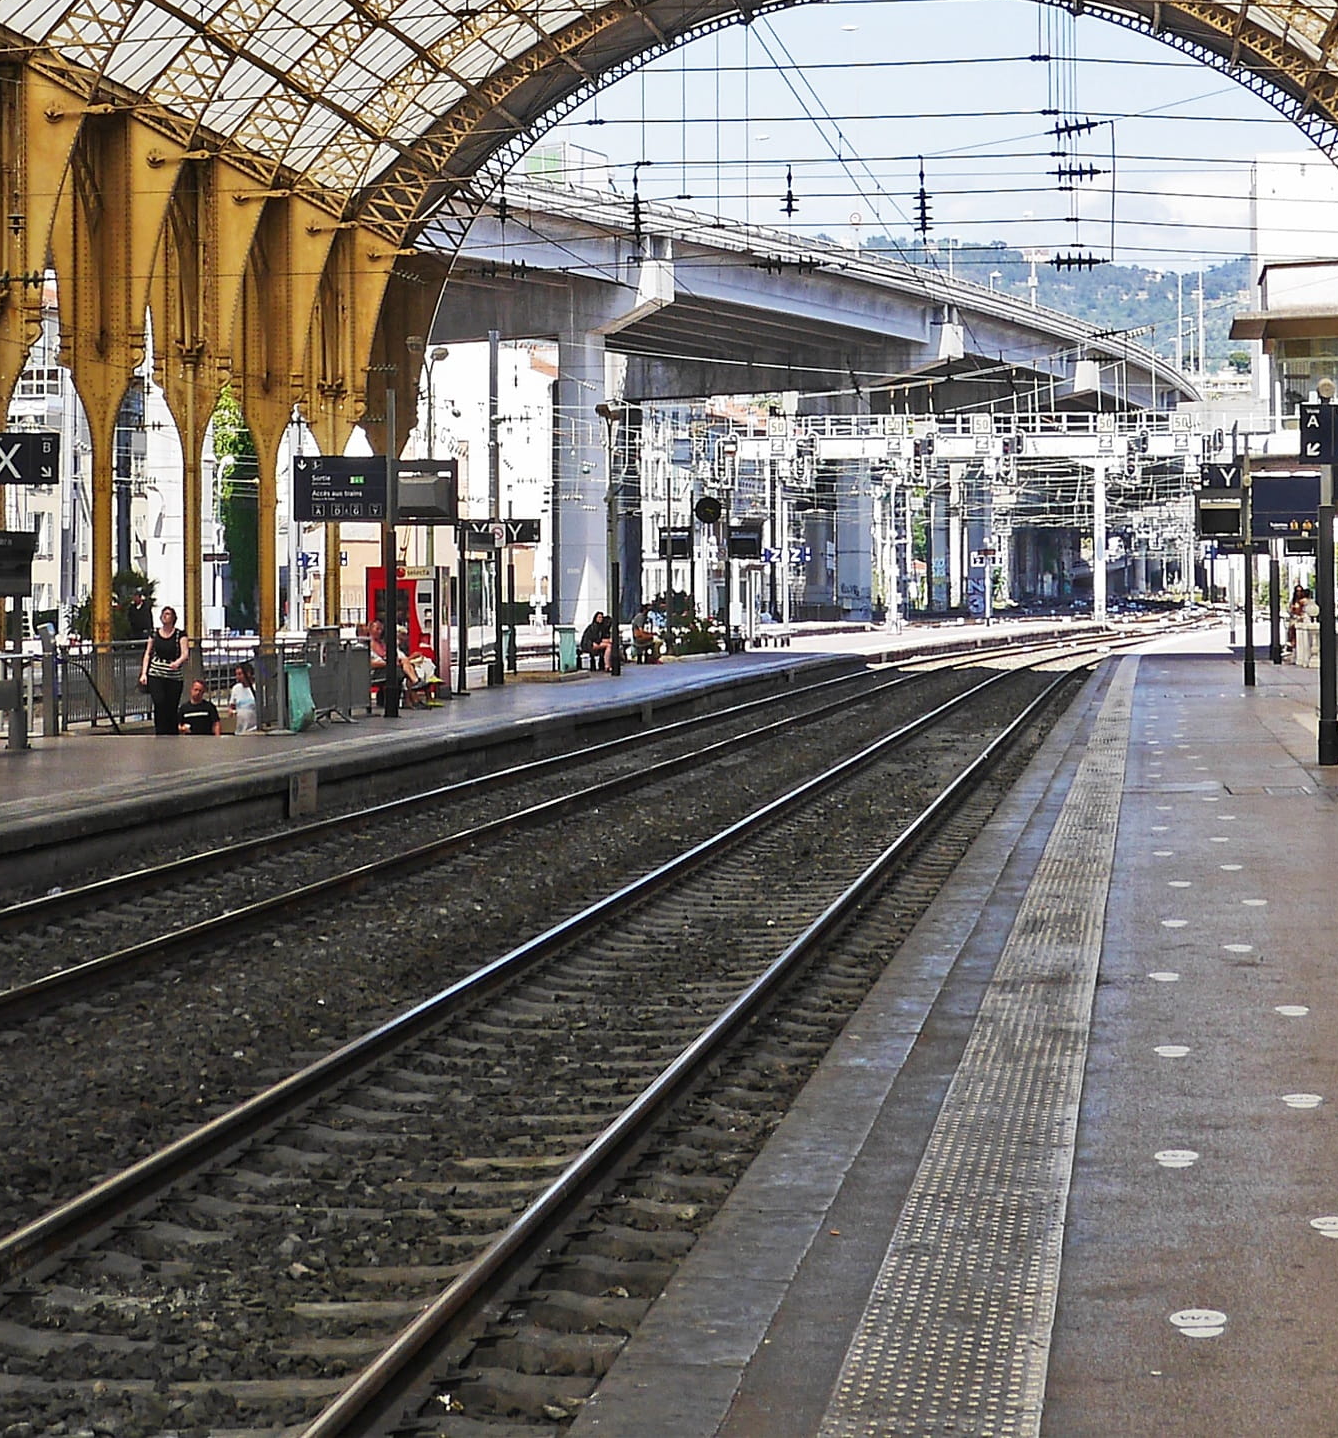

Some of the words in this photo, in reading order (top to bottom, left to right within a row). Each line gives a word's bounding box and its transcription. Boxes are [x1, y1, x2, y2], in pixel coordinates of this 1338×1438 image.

[1307, 415, 1319, 428] A
[43, 442, 51, 453] B
[1219, 468, 1236, 487] Y
[508, 523, 522, 541] Y
